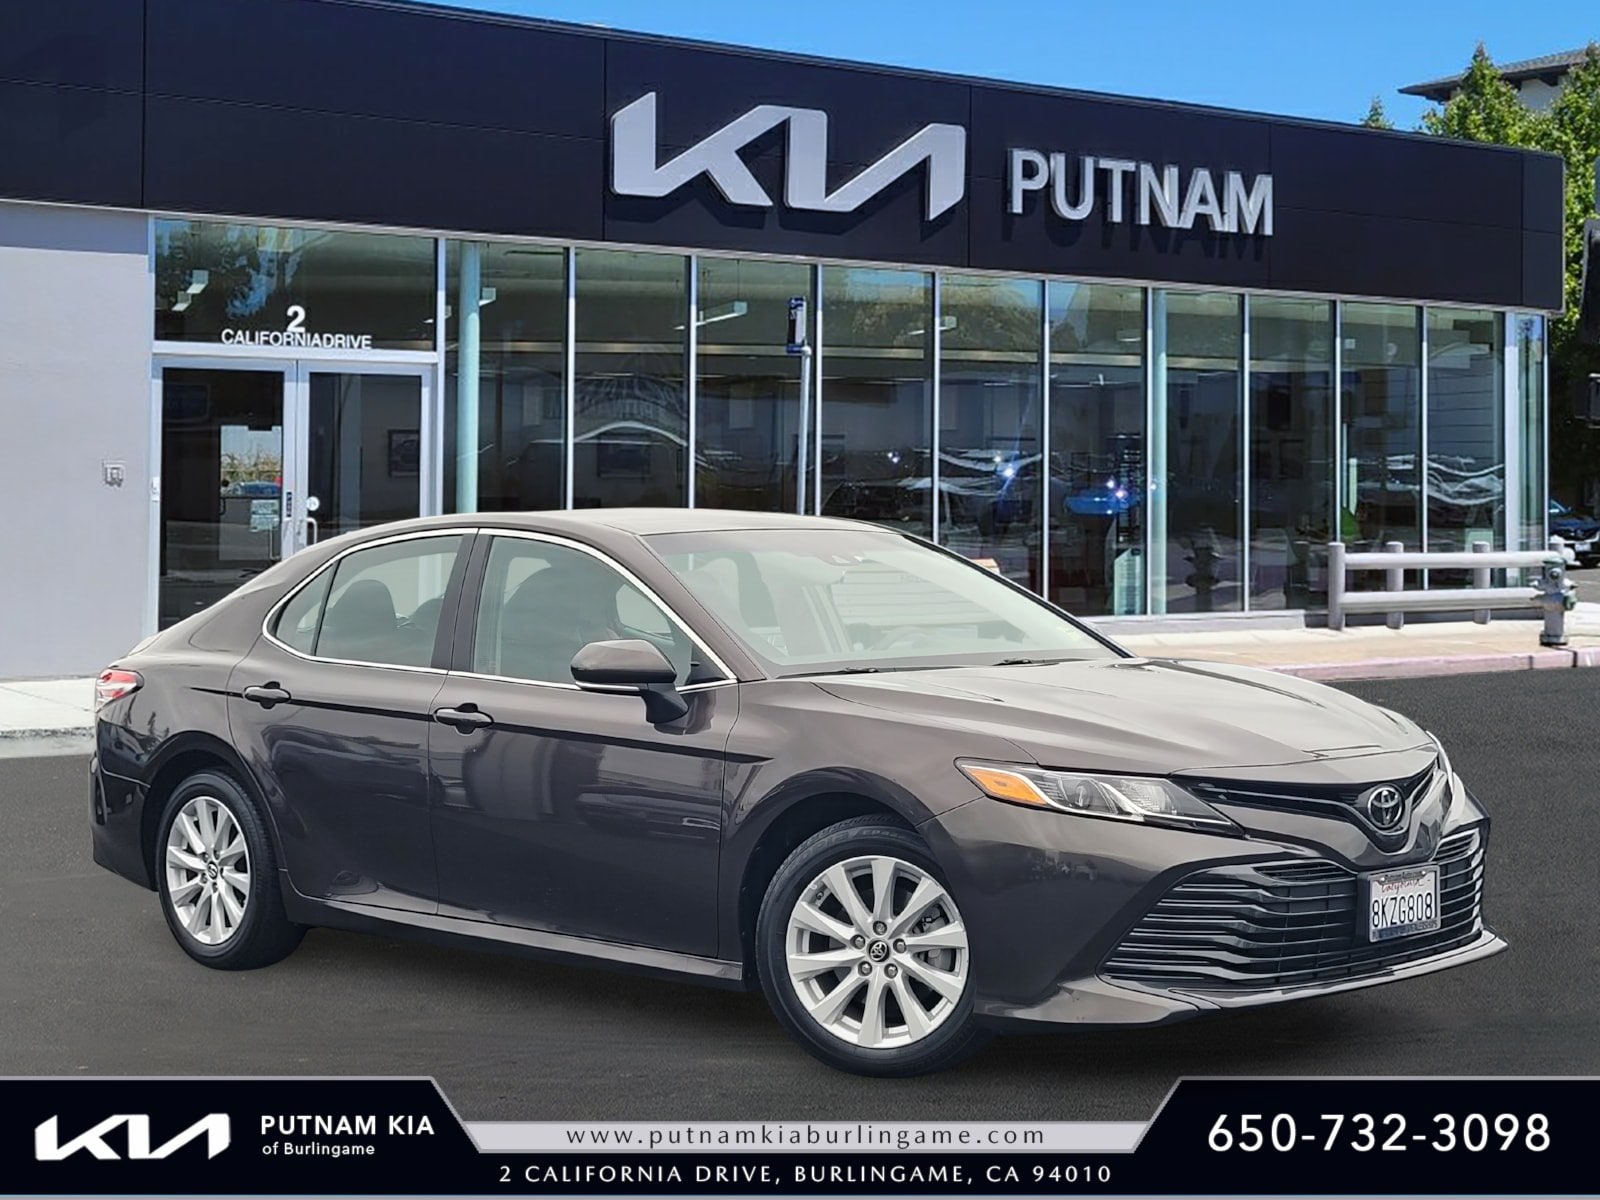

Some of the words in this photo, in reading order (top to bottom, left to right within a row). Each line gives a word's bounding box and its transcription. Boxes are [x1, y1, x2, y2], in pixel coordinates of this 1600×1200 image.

[610, 91, 966, 220] KIA
[1008, 148, 1274, 236] PUTNAM
[286, 305, 306, 333] 2
[1372, 892, 1433, 928] 8KZG808
